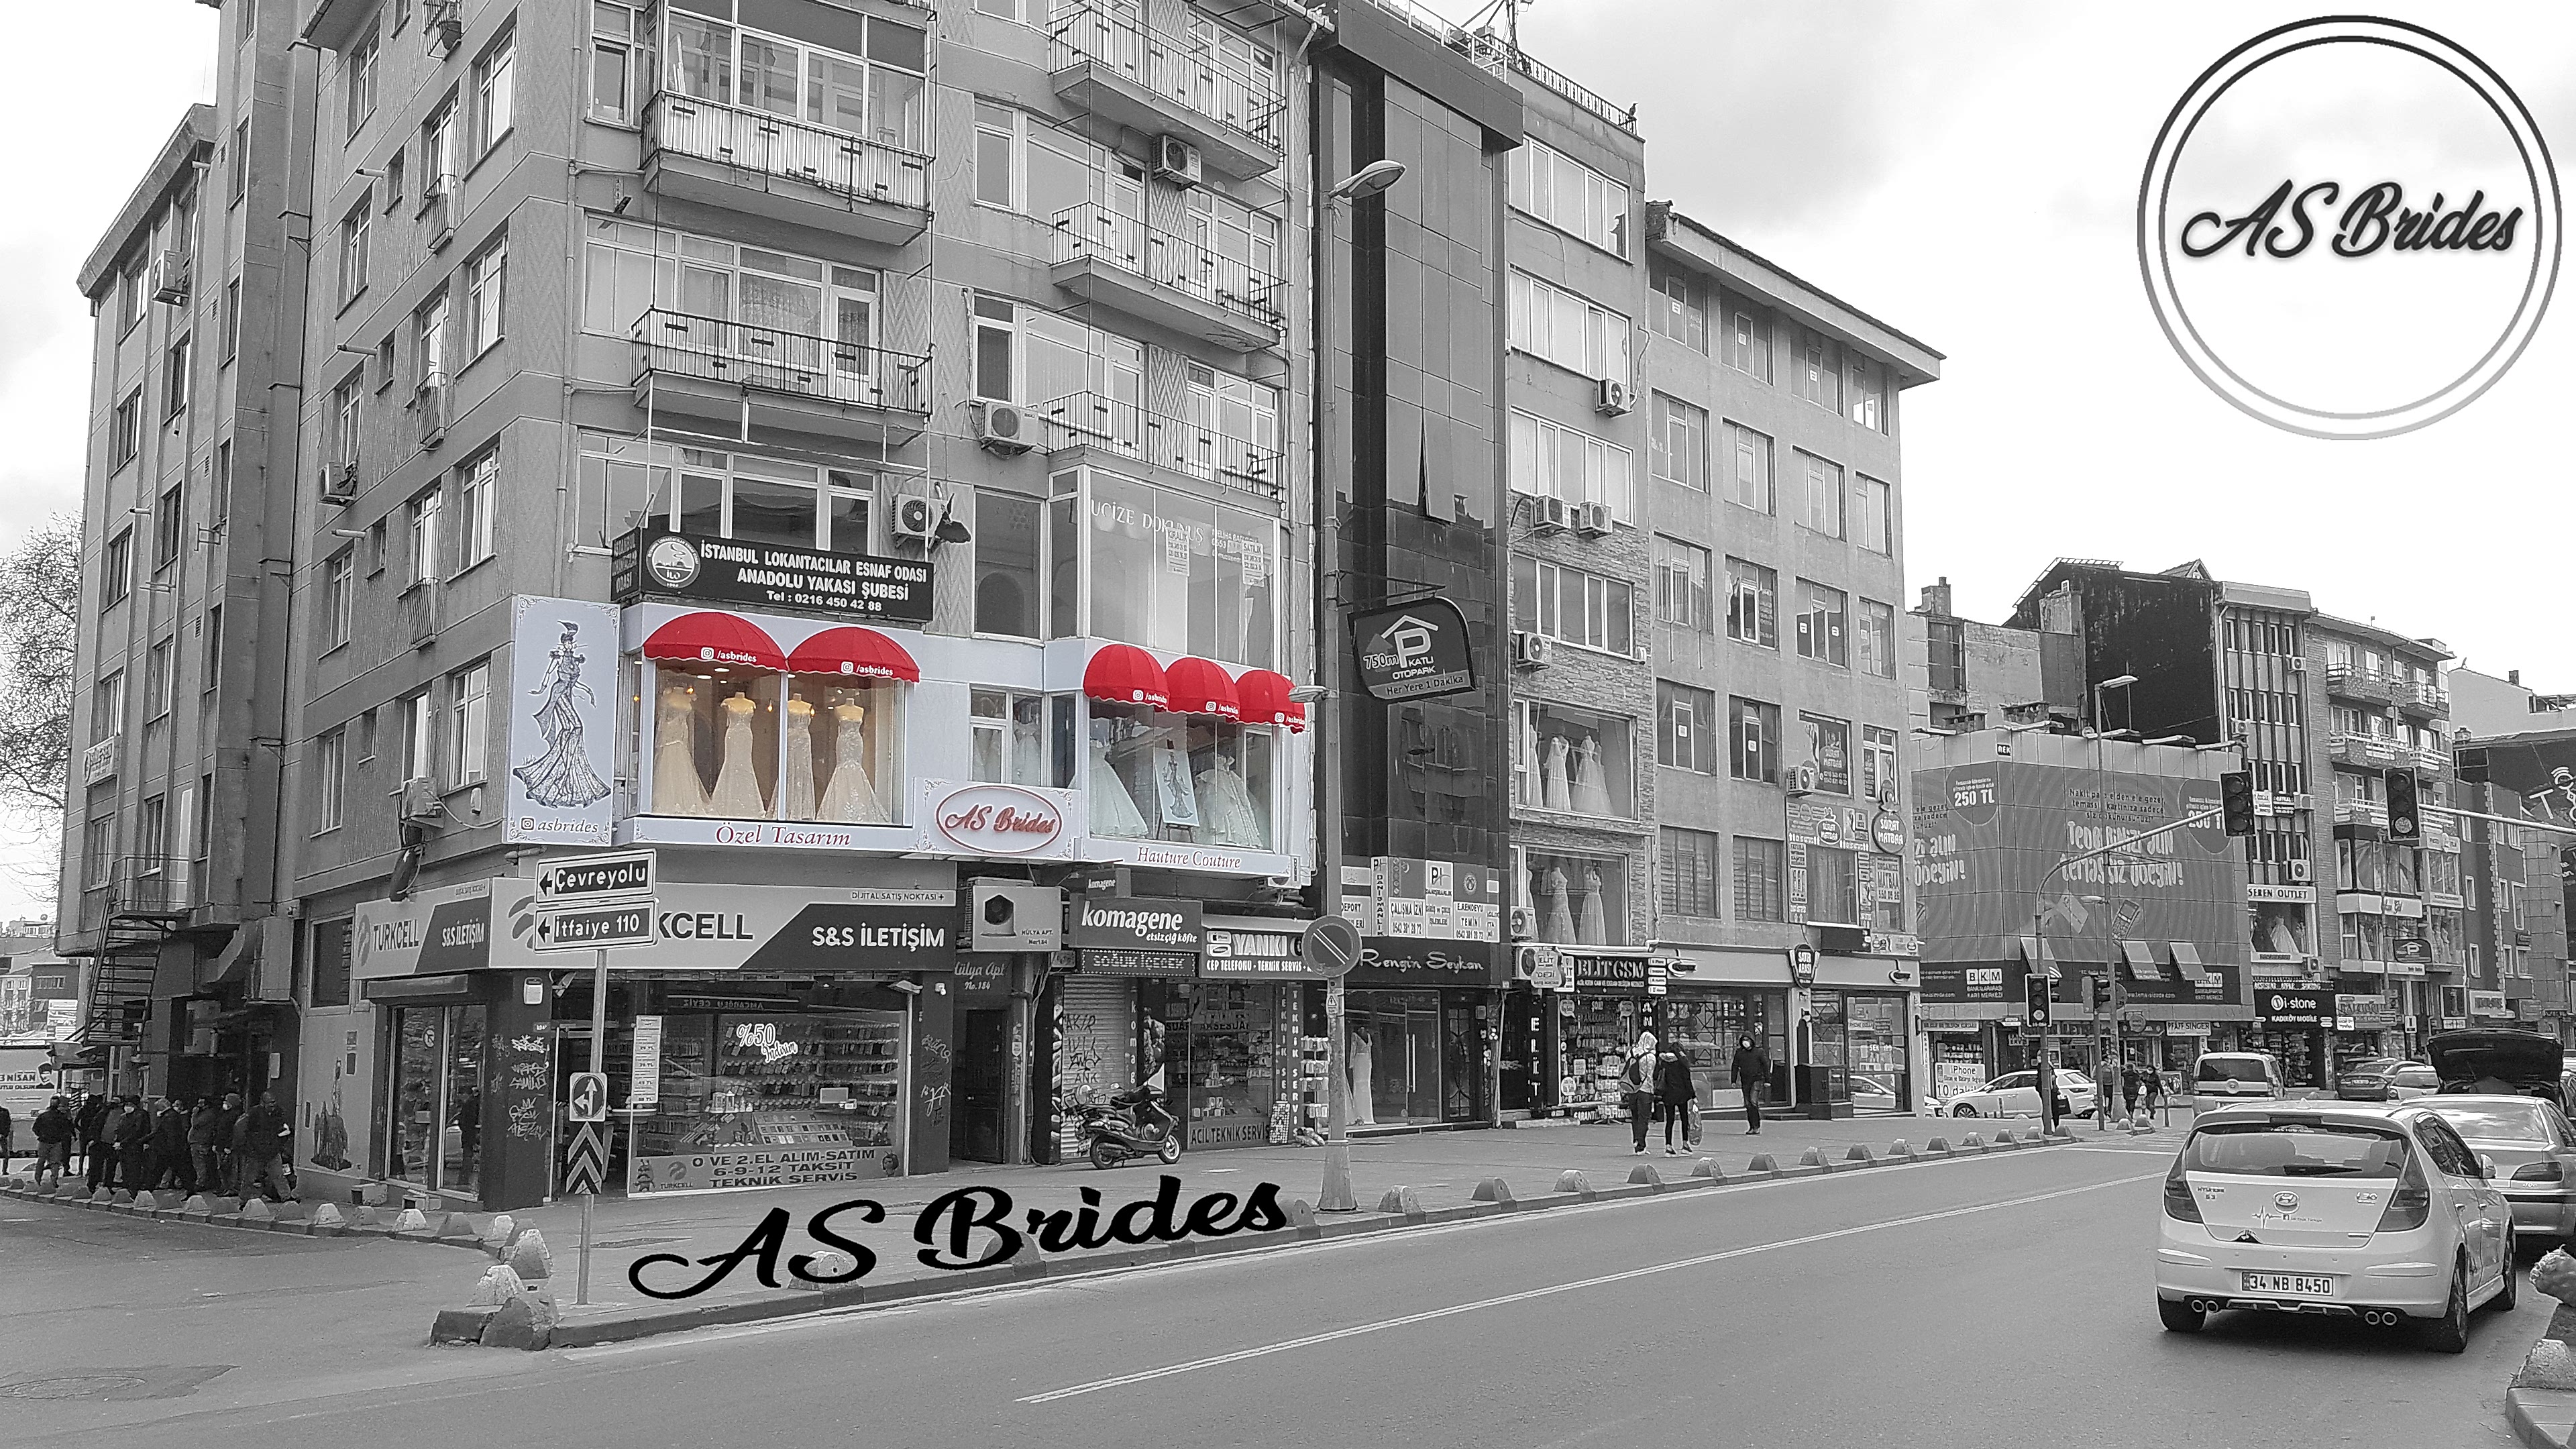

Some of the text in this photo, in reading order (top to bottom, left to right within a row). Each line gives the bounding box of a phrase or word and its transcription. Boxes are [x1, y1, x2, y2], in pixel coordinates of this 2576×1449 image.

[701, 539, 759, 564] İSTANBUL
[765, 551, 851, 575] LOKANTACILAR
[856, 561, 892, 579] ESNAF
[894, 565, 927, 583] ODASI
[737, 568, 909, 601] ANADOLU YAKASI ŞUBESİ
[766, 590, 785, 602] Tel
[794, 593, 824, 605] 0216
[826, 597, 848, 608] 450
[849, 600, 865, 610] 42
[867, 602, 882, 612] 88
[717, 650, 757, 663] /asbrides
[1363, 653, 1400, 669] 750m
[1408, 655, 1434, 667] KATLI
[855, 664, 894, 676] /asbrides
[1392, 665, 1436, 680] OTOPARK
[1386, 675, 1464, 695] Her Yere 1 Dakika
[1954, 788, 1995, 807] 250 TL
[2090, 791, 2107, 799] paa
[2131, 794, 2142, 802] ele
[2072, 799, 2102, 808] temassı
[2139, 804, 2163, 814] sadece
[537, 817, 599, 833] asbrides
[944, 804, 1057, 834] AS Brides
[1880, 816, 1900, 832] SÜRAT
[2214, 812, 2222, 830] T
[716, 821, 851, 846] Özel Tasarım
[1878, 831, 1904, 845] MATBAA
[1137, 847, 1241, 869] Hauture Couture
[555, 863, 646, 892] Çevreyolu
[1087, 878, 1116, 891] komagene
[881, 892, 903, 901] SATIŞ
[904, 892, 937, 901] NOKTASI
[2248, 888, 2308, 900] SEREN OUTLET
[555, 913, 640, 940] İtfaiye 110
[658, 912, 754, 941] KCELL
[1081, 900, 1183, 937] komagene
[373, 919, 419, 952] TURKCELL
[812, 922, 945, 952] S&S İLETİŞİM
[1232, 933, 1287, 957] YANKI
[1093, 953, 1138, 968] SOĞUK
[1206, 959, 1302, 972] CEP TELEFONU TEKNİK SERVİS
[1360, 948, 1422, 973] Rengin
[1613, 959, 1644, 979] GSM
[1968, 970, 2001, 983] BKM
[737, 1022, 776, 1047] %50
[2186, 1021, 2210, 1031] SINGER
[1937, 1084, 1949, 1097] 10
[1191, 1122, 1270, 1144] ACİL TEKNİK SERVİS
[710, 1149, 875, 1167] VE 2.EL ALIM-SATIM
[714, 1161, 855, 1177] 6-9-12 TAKSİT
[660, 1181, 694, 1189] TURKCELL
[709, 1171, 858, 1189] TEKNİK SERVİS
[2249, 1275, 2330, 1293] 34 NB 8450
